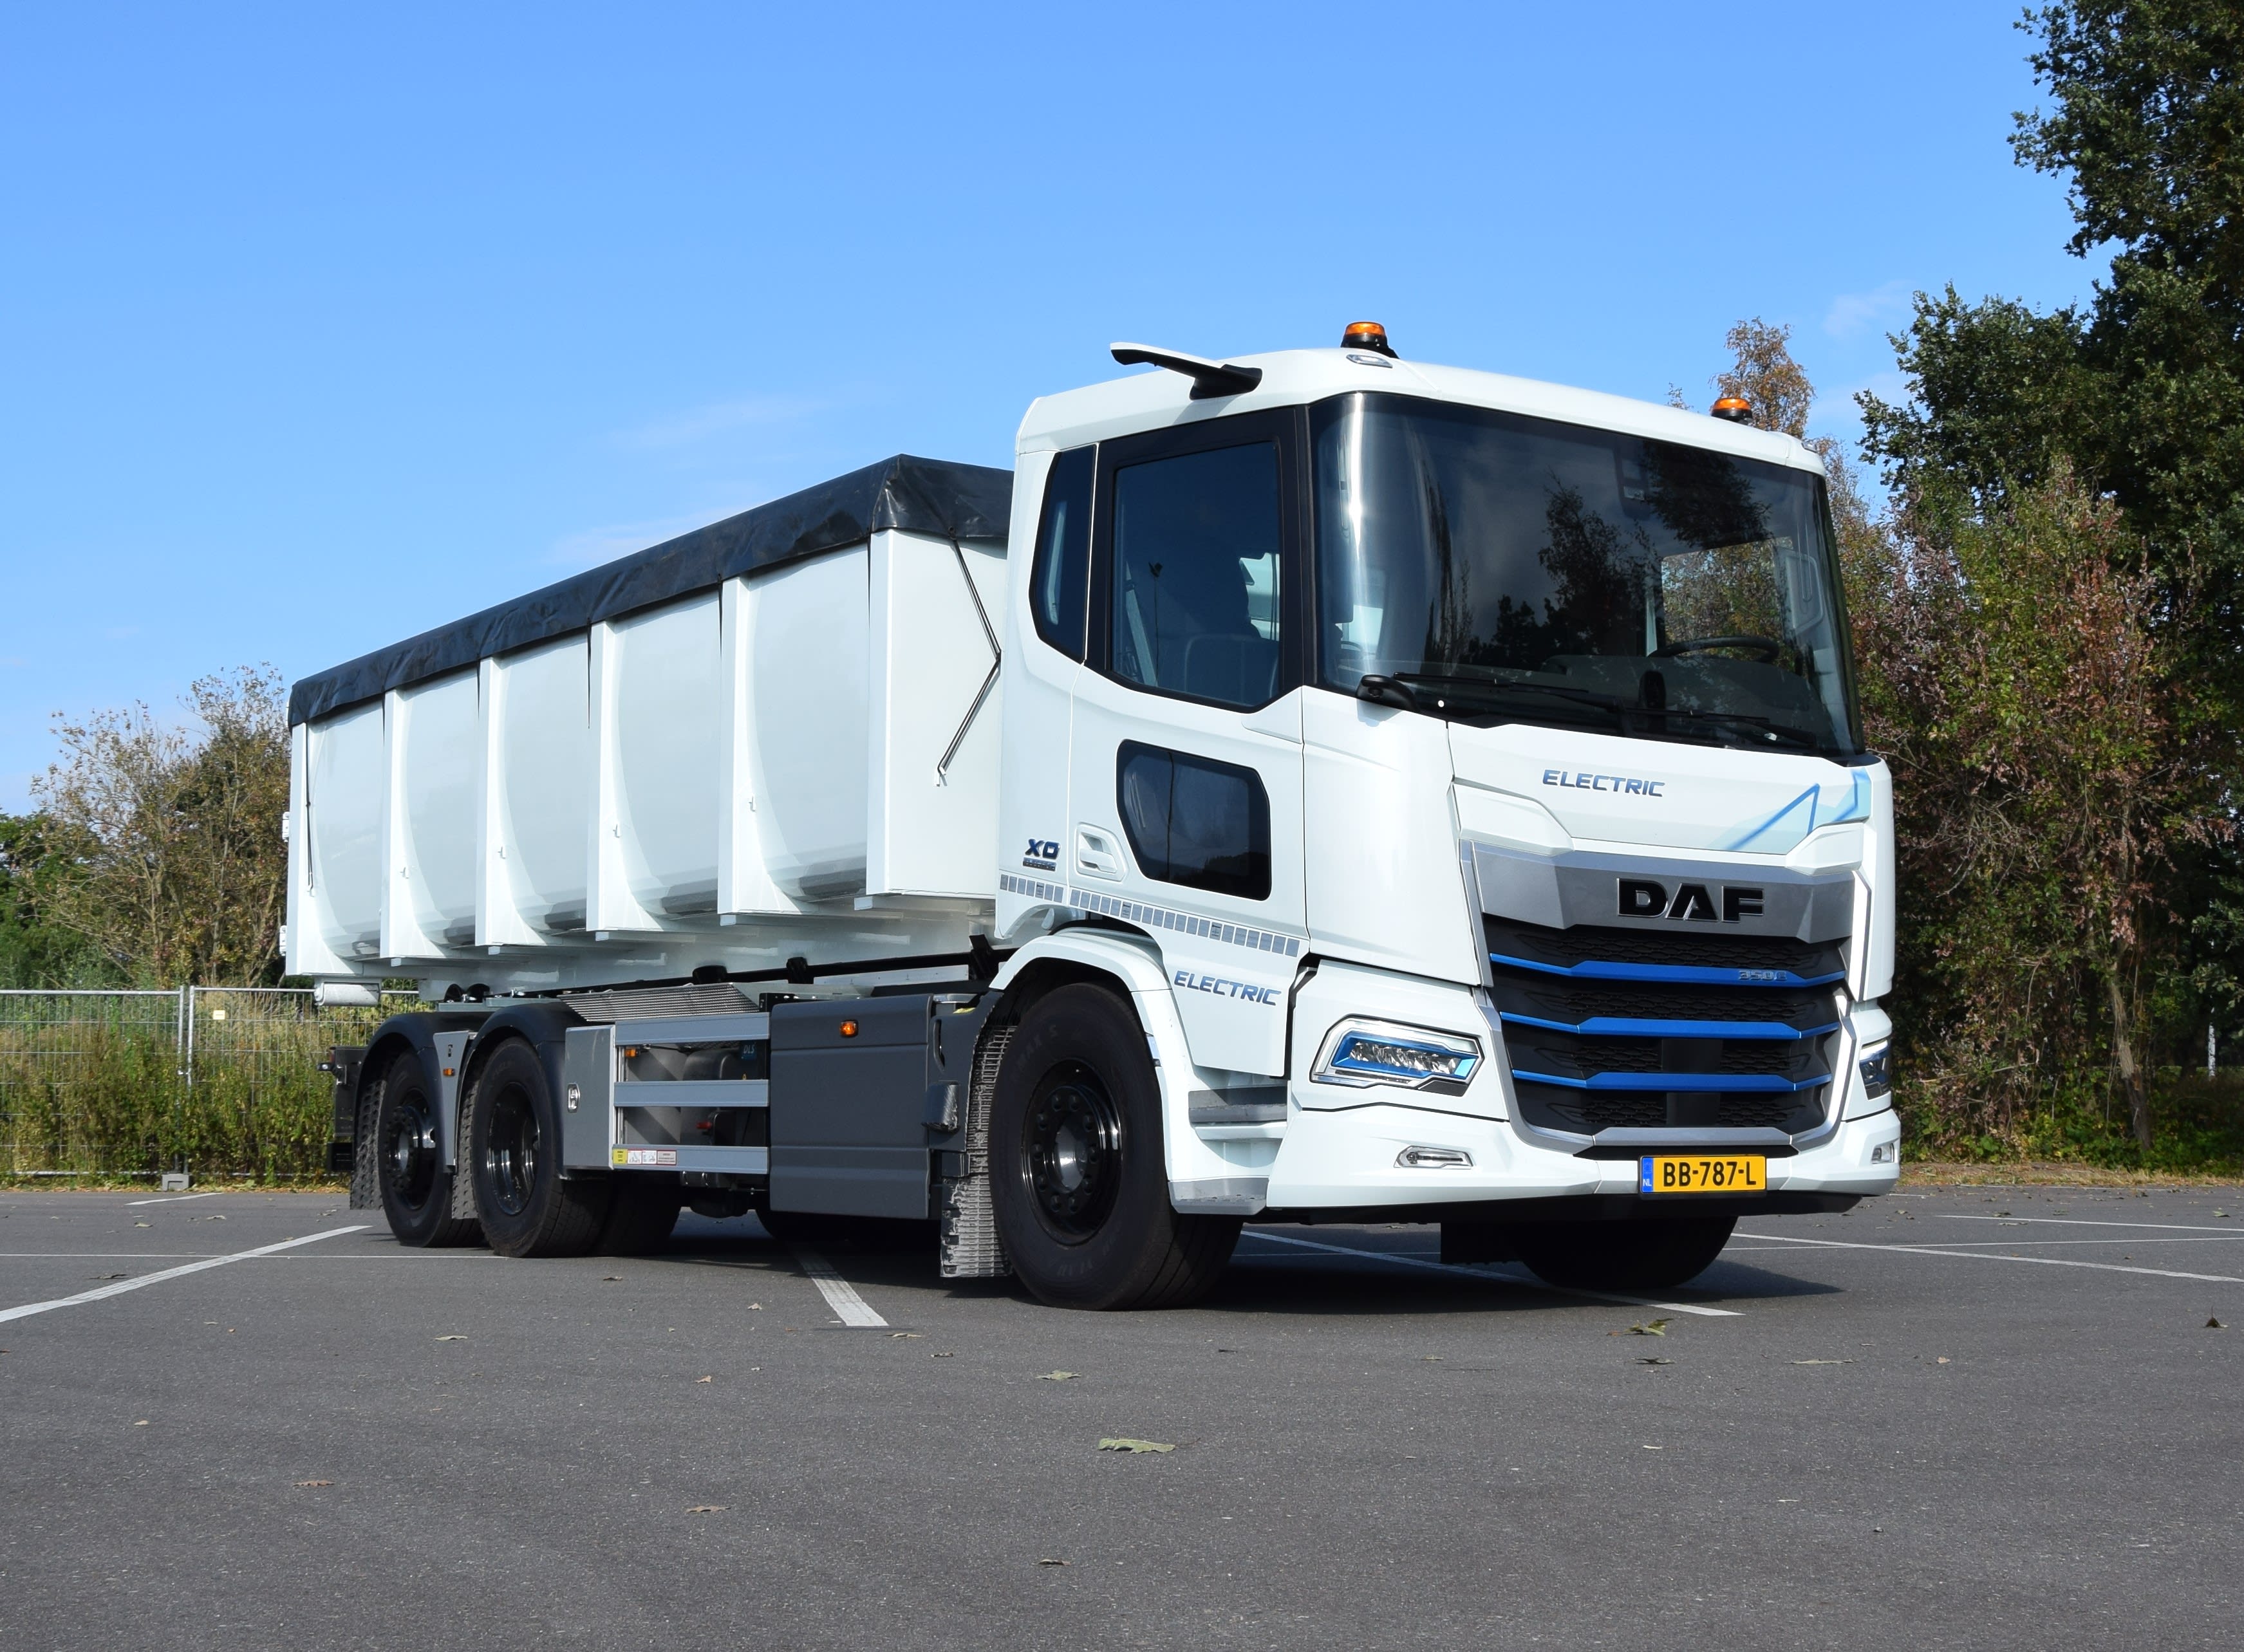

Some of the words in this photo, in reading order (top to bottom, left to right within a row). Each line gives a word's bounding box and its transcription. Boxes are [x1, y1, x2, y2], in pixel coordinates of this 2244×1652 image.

[1542, 769, 1665, 797] ELECTRIC
[1616, 878, 1764, 923] DAF
[1173, 970, 1282, 1006] ELECTRIC
[1643, 1178, 1652, 1187] NL
[1663, 1161, 1757, 1187] BB-787-L
